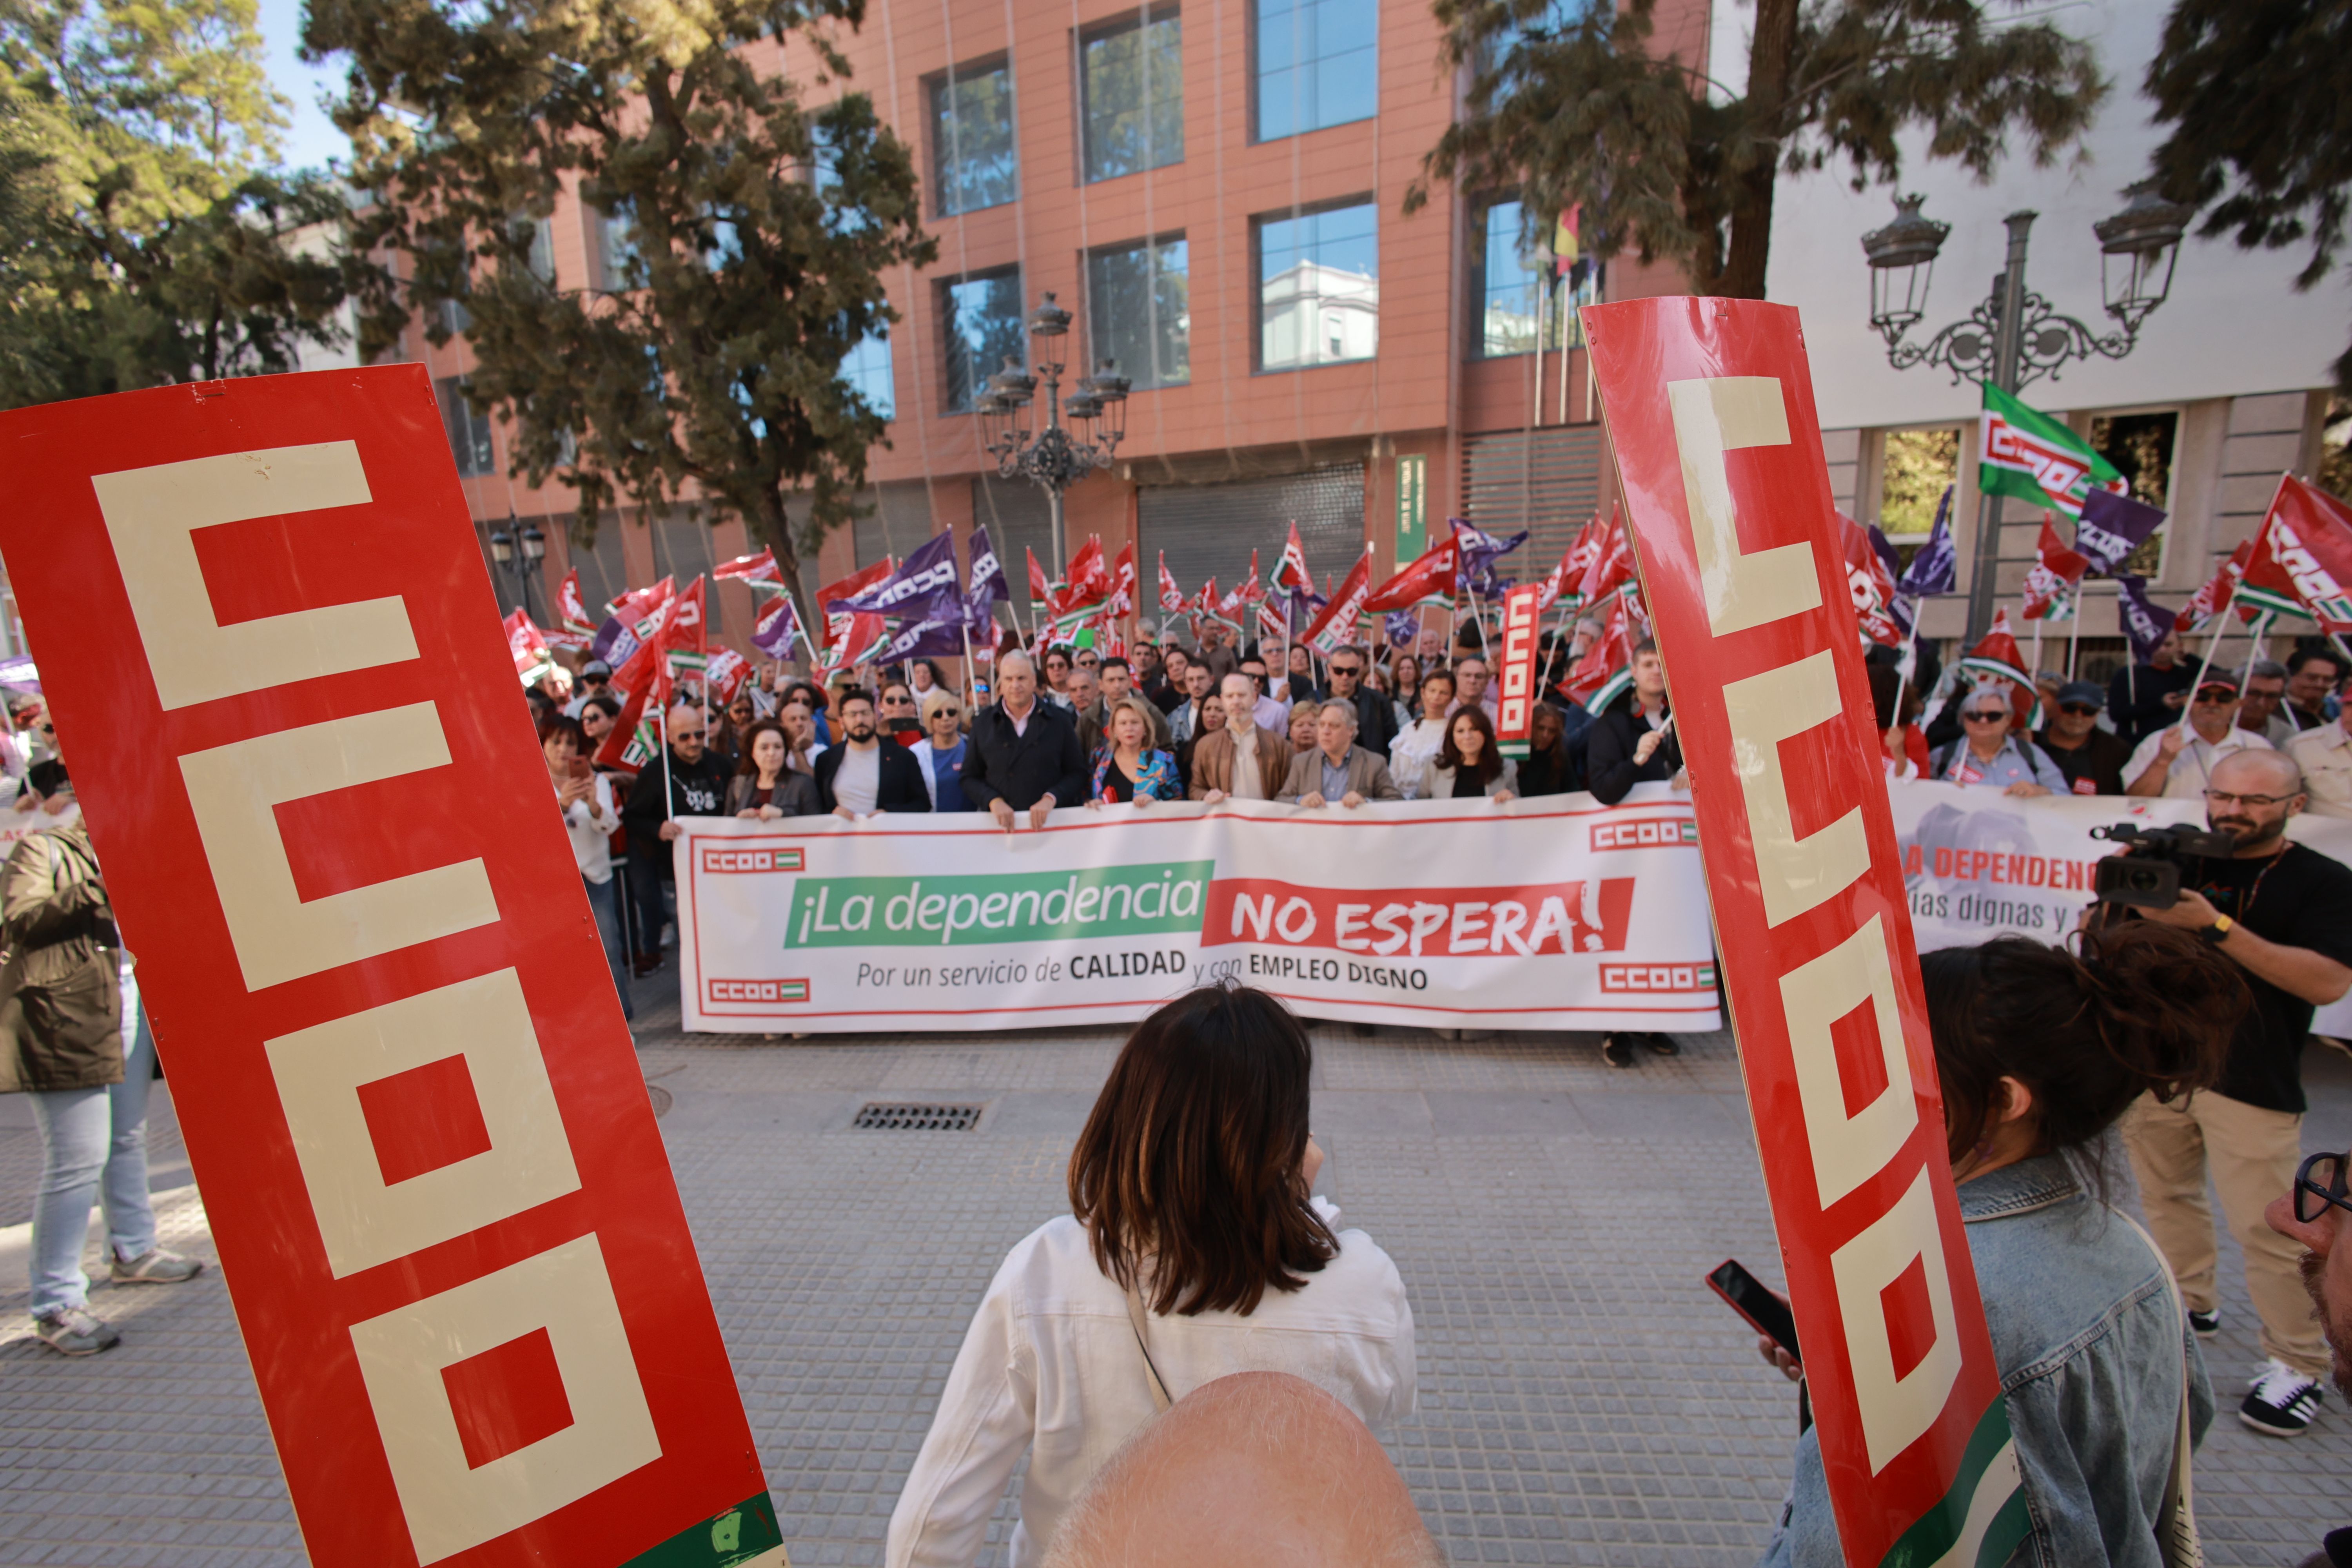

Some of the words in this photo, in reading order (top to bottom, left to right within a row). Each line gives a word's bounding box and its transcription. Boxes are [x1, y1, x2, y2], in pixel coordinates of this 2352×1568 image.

[1501, 593, 1533, 732] CCOO
[1595, 822, 1679, 847] CCOO
[706, 852, 772, 871] CCOO
[798, 886, 875, 944] ¡La
[885, 869, 1201, 944] dependencia
[1231, 892, 1316, 943] NO
[1335, 880, 1604, 956] ESPERA!
[1668, 377, 1962, 1478] CCOO
[1960, 892, 2043, 927] dignas
[2054, 906, 2068, 934] y
[857, 963, 896, 987] Por
[903, 967, 931, 986] un
[939, 959, 1027, 987] servicio
[1035, 956, 1062, 982] de
[1070, 950, 1186, 979] CALIDAD
[1193, 963, 1205, 988] y
[1210, 958, 1242, 978] con
[1250, 954, 1339, 980] EMPLEO
[1348, 962, 1428, 990] DIGNO
[1604, 967, 1693, 988] CCOO
[90, 440, 662, 1567] CCOO
[711, 982, 777, 1000] CCOO
